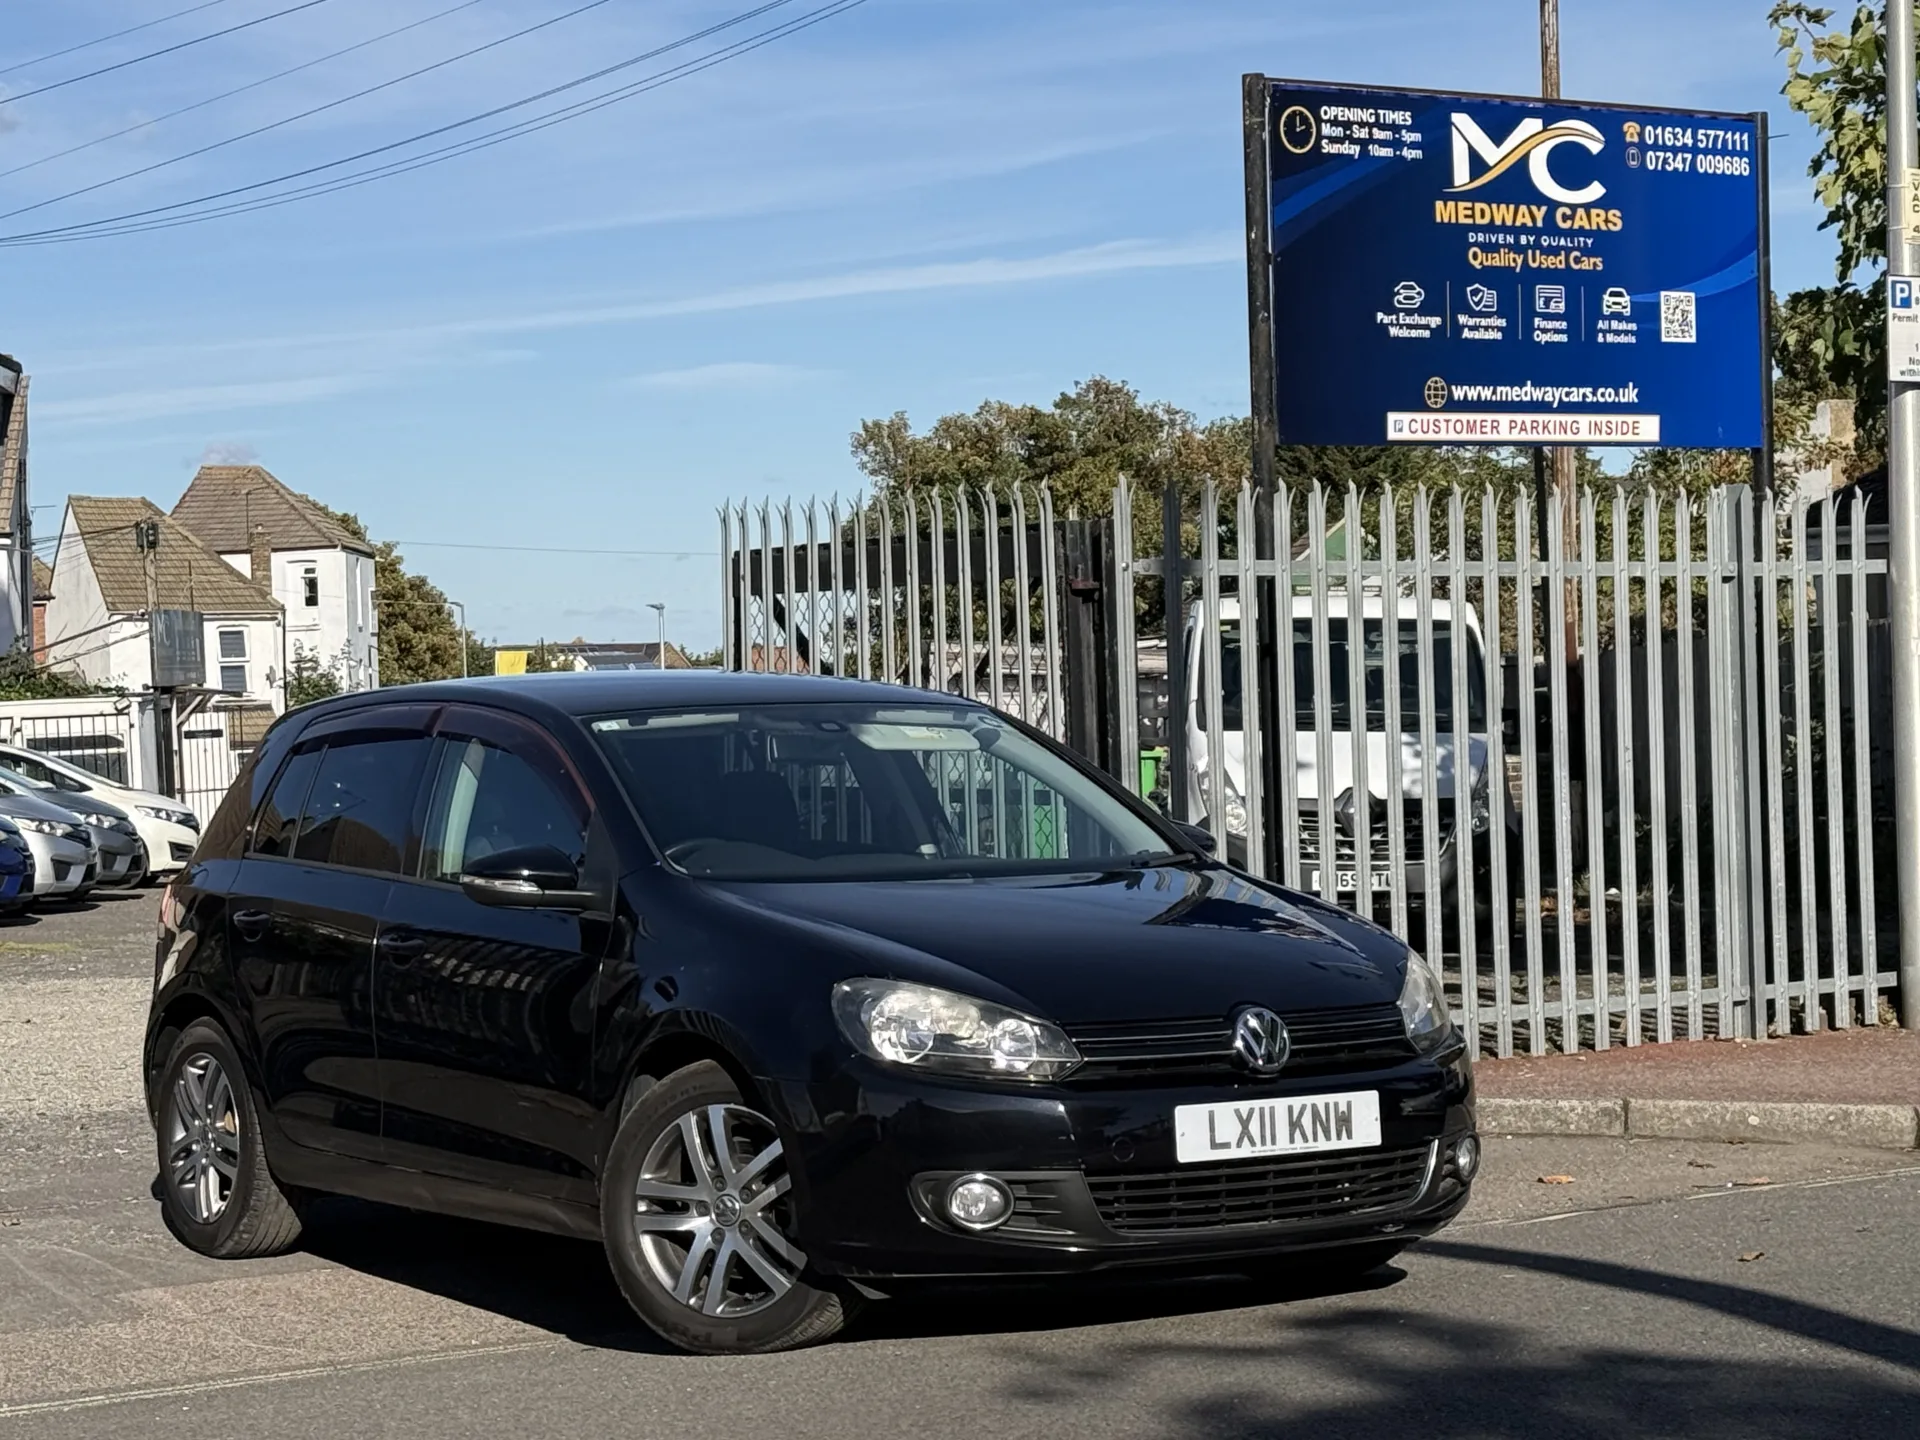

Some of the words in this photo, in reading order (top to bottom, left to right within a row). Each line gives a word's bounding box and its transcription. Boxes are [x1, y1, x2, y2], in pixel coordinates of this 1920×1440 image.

[1320, 105, 1376, 123] OPENING
[1377, 109, 1412, 126] TIMES
[1321, 122, 1344, 137] Mon
[1352, 125, 1370, 139] Sat
[1372, 127, 1393, 141] 9am
[1401, 129, 1422, 144] 5pm
[1645, 125, 1693, 148] 01634
[1697, 129, 1749, 152] 577111
[1321, 139, 1361, 160] Sunday
[1368, 143, 1394, 158] 10am
[1401, 146, 1423, 161] 4pm
[1646, 151, 1693, 173] 07347
[1696, 154, 1750, 176] 009686
[1434, 200, 1548, 228] MEDWAY
[1555, 206, 1624, 231] CARS
[1468, 232, 1515, 245] DRIVEN
[1520, 234, 1536, 245] BY
[1541, 235, 1594, 248] QUALITY
[1468, 246, 1524, 273] Quality
[1527, 249, 1566, 270] Used
[1569, 251, 1604, 271] Cars
[1376, 311, 1397, 324] Part
[1398, 312, 1442, 329] Exchange
[1457, 314, 1507, 327] Warranties
[1533, 317, 1568, 330] Finance
[1597, 319, 1610, 331] All
[1610, 320, 1638, 331] Makes
[1892, 312, 1919, 323] Permit
[1388, 325, 1431, 339] Welcome
[1461, 327, 1503, 340] Available
[1533, 330, 1568, 345] Options
[1597, 332, 1605, 343] &
[1605, 333, 1637, 344] Models
[1451, 380, 1639, 408] www.medwaycars.co.uk
[1408, 418, 1501, 435] CUSTOMER
[1508, 419, 1581, 436] PARKING
[1588, 420, 1641, 436] INSIDE
[1208, 1105, 1278, 1151] LX11
[1287, 1100, 1354, 1145] KNW
